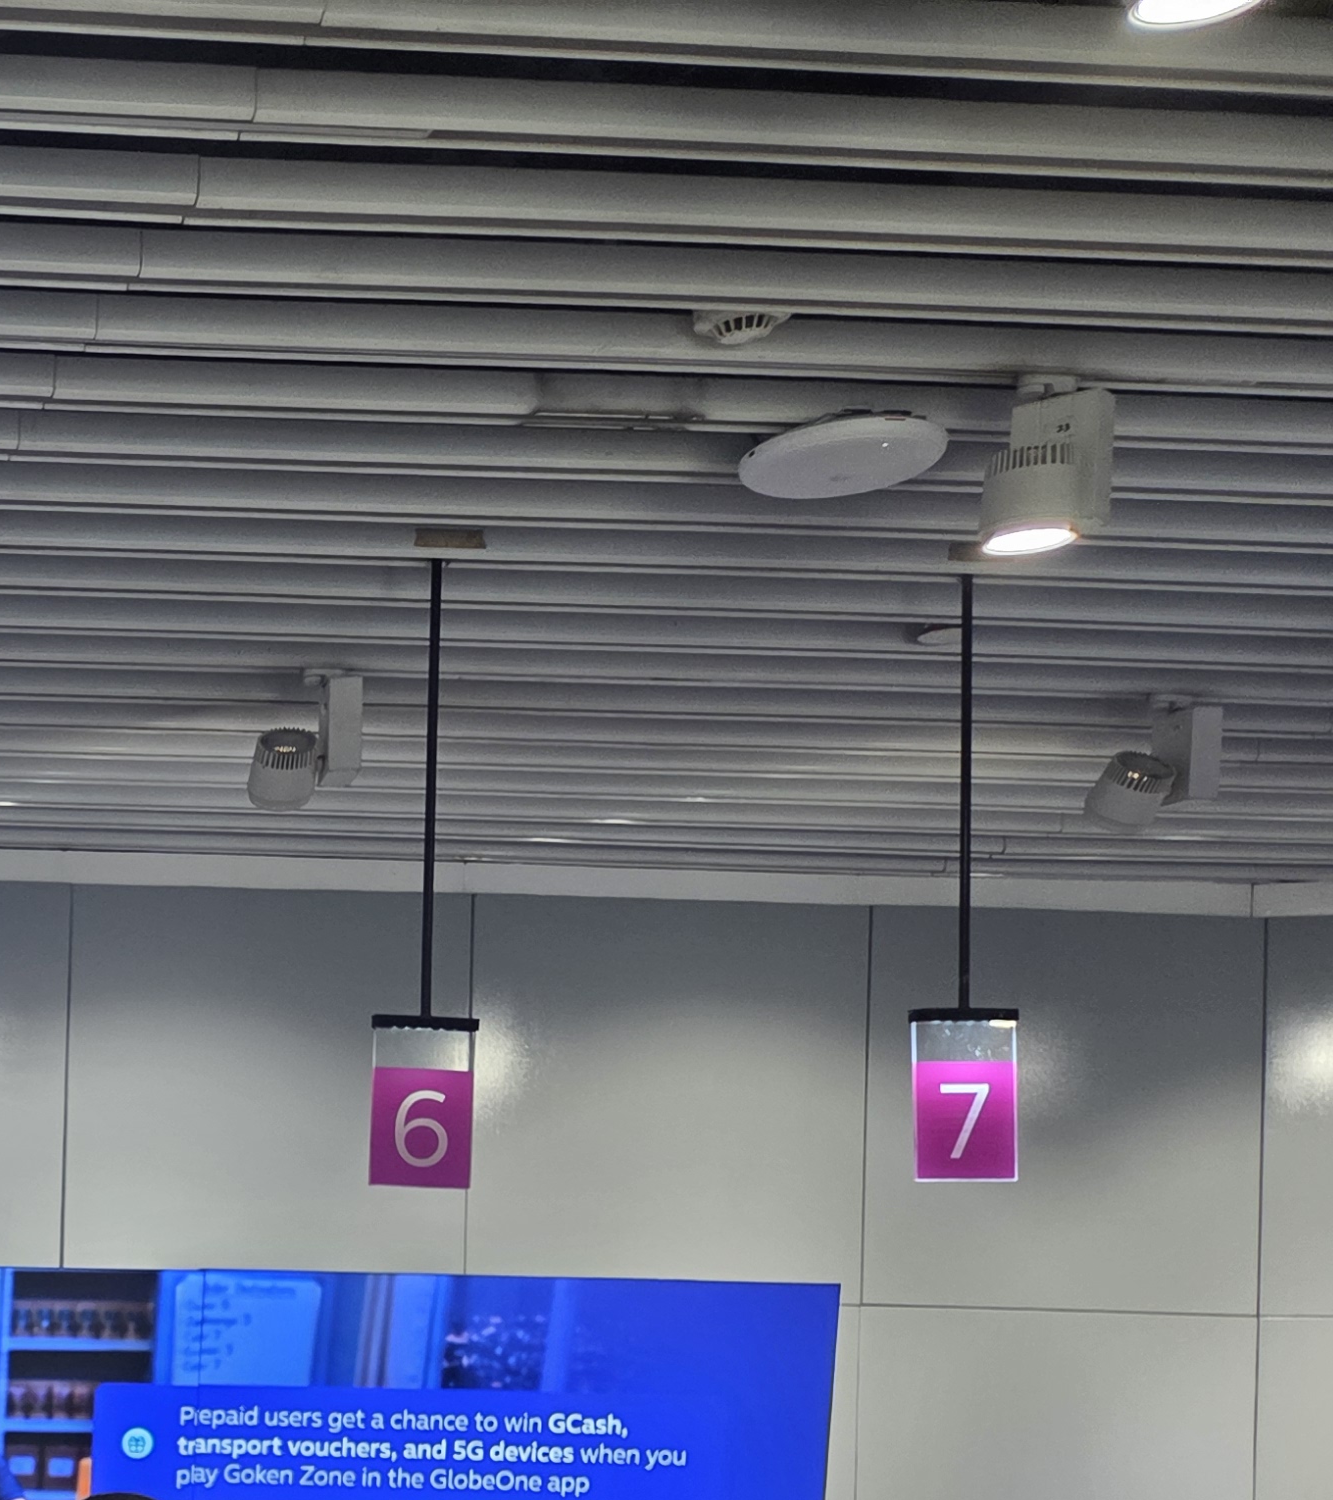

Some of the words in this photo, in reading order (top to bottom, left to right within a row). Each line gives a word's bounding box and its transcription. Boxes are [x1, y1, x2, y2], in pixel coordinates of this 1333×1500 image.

[394, 1089, 449, 1168] 6
[939, 1083, 991, 1159] 7
[180, 1405, 259, 1430] Prepaid
[264, 1409, 323, 1428] users
[327, 1409, 365, 1433] get
[370, 1412, 385, 1430] a
[390, 1408, 469, 1432] chance
[474, 1412, 498, 1433] to
[503, 1411, 542, 1434] win
[547, 1412, 628, 1439] GCash,
[176, 1436, 283, 1460] transport
[287, 1436, 398, 1463] vouchers,
[402, 1438, 447, 1461] and
[452, 1439, 484, 1462] 5G
[489, 1439, 575, 1464] devices
[579, 1442, 640, 1466] when
[644, 1449, 687, 1472] you
[176, 1464, 219, 1490] play
[223, 1463, 293, 1485] Goken
[299, 1465, 356, 1487] Zone
[361, 1466, 381, 1488] in
[387, 1466, 425, 1489] the
[429, 1468, 542, 1492] GlobeOne
[547, 1475, 591, 1498] app
